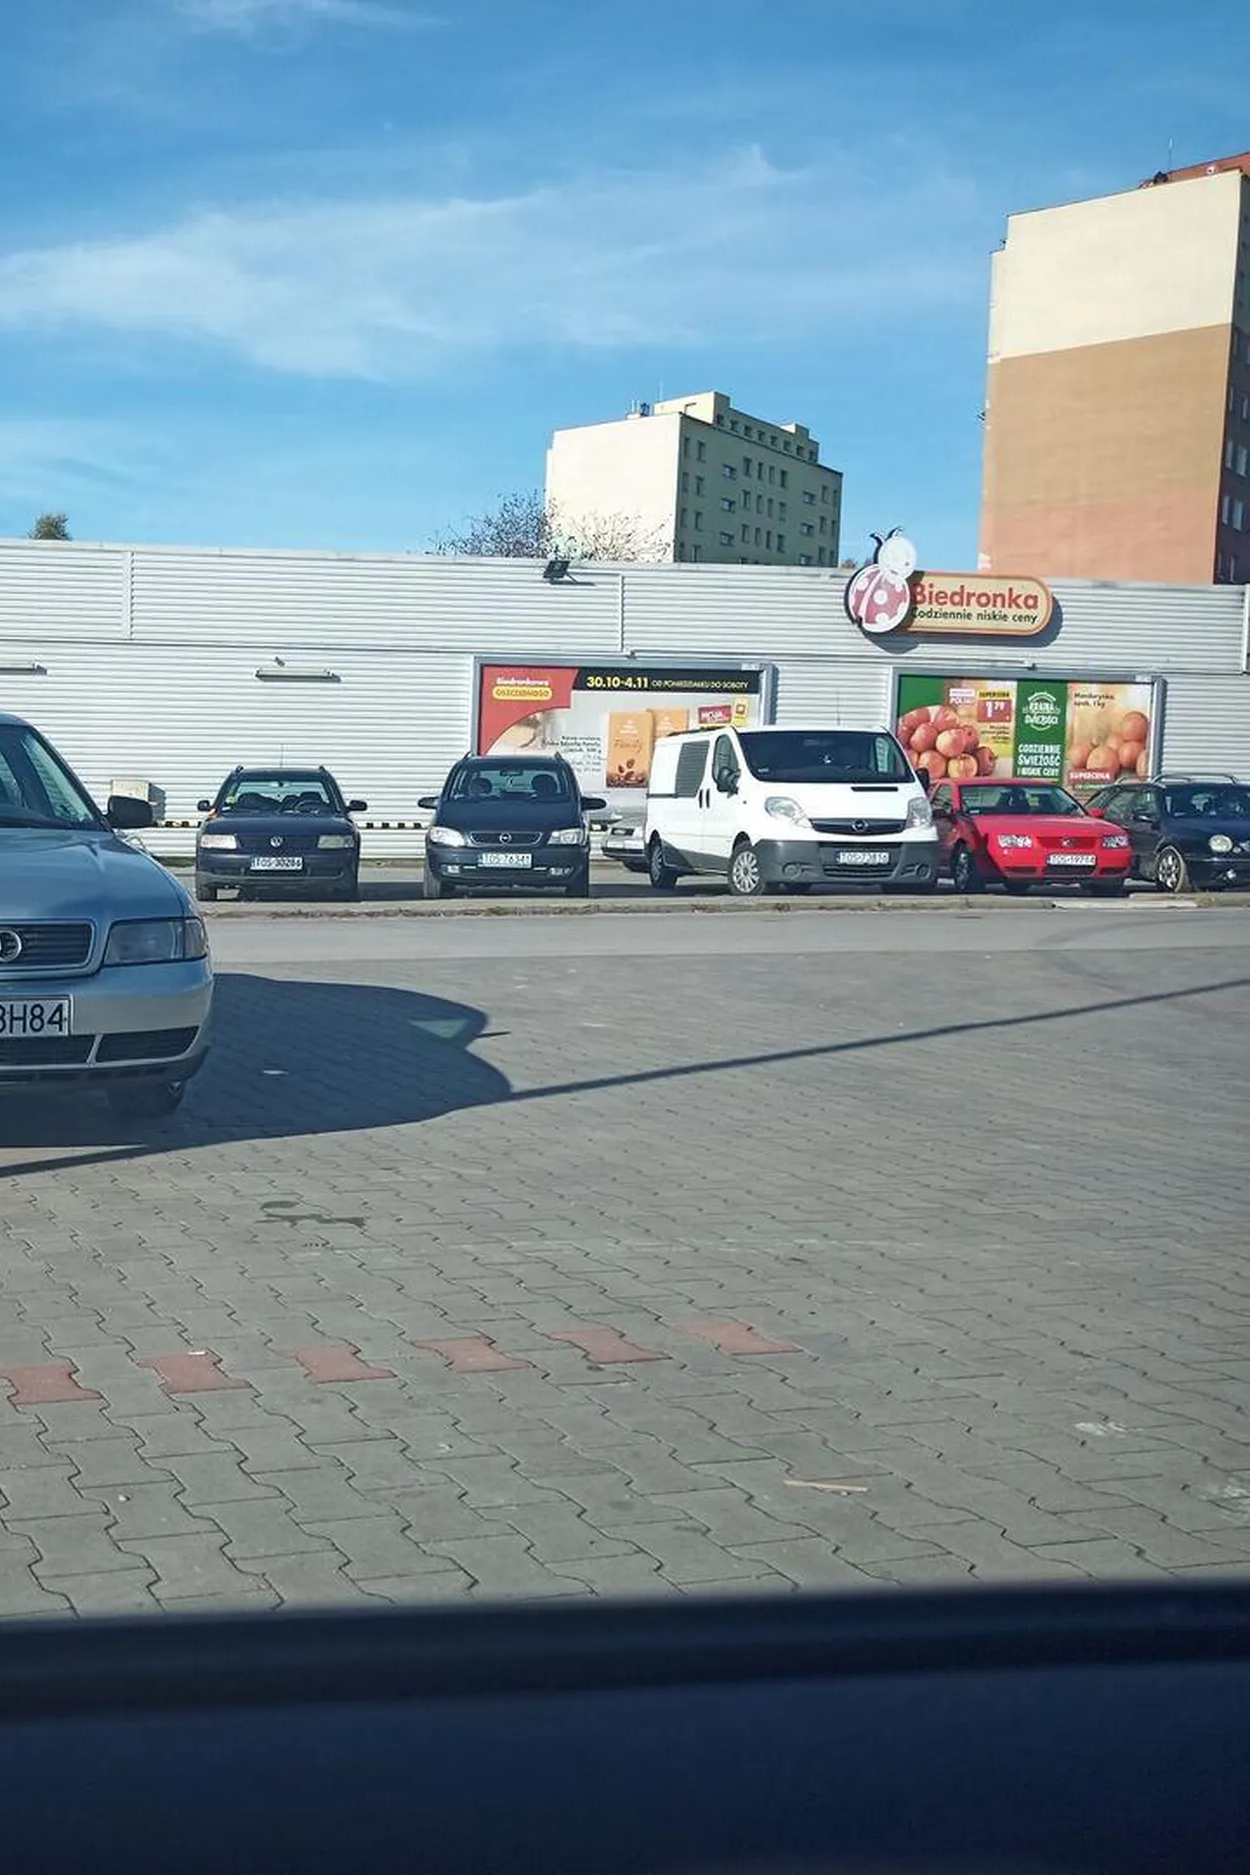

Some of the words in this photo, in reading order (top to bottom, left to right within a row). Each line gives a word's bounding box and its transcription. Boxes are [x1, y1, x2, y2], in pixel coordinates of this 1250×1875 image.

[911, 583, 1039, 610] Biedronka
[912, 607, 972, 621] Codziennie
[977, 610, 1008, 622] niskie
[1012, 613, 1038, 625] ceny
[586, 676, 649, 689] 30.10-4.11
